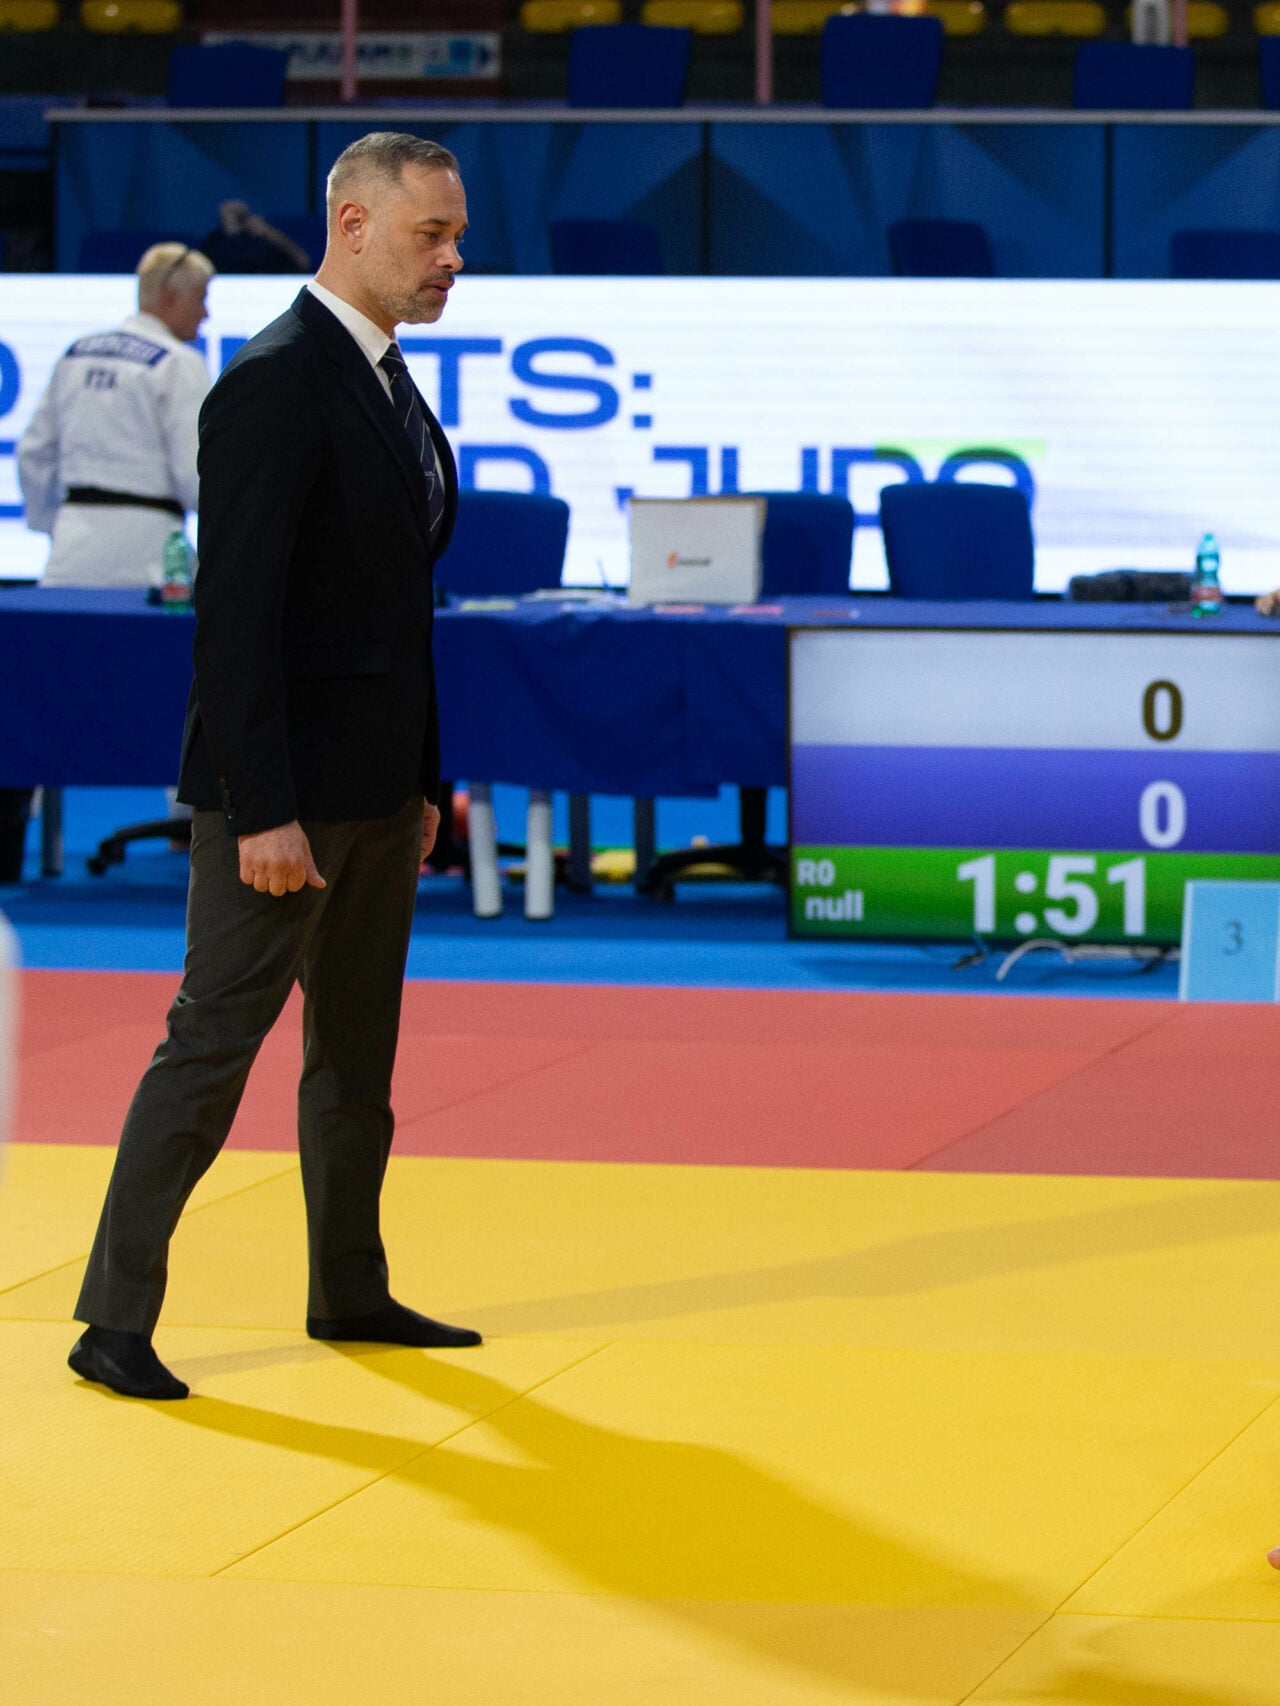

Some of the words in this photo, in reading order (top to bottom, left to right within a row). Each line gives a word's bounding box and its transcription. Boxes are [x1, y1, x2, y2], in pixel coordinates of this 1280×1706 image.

[1141, 679, 1184, 743] 0
[1139, 780, 1187, 849] 0
[805, 891, 864, 921] null
[957, 854, 1147, 936] 1:51
[1222, 920, 1245, 957] 3
